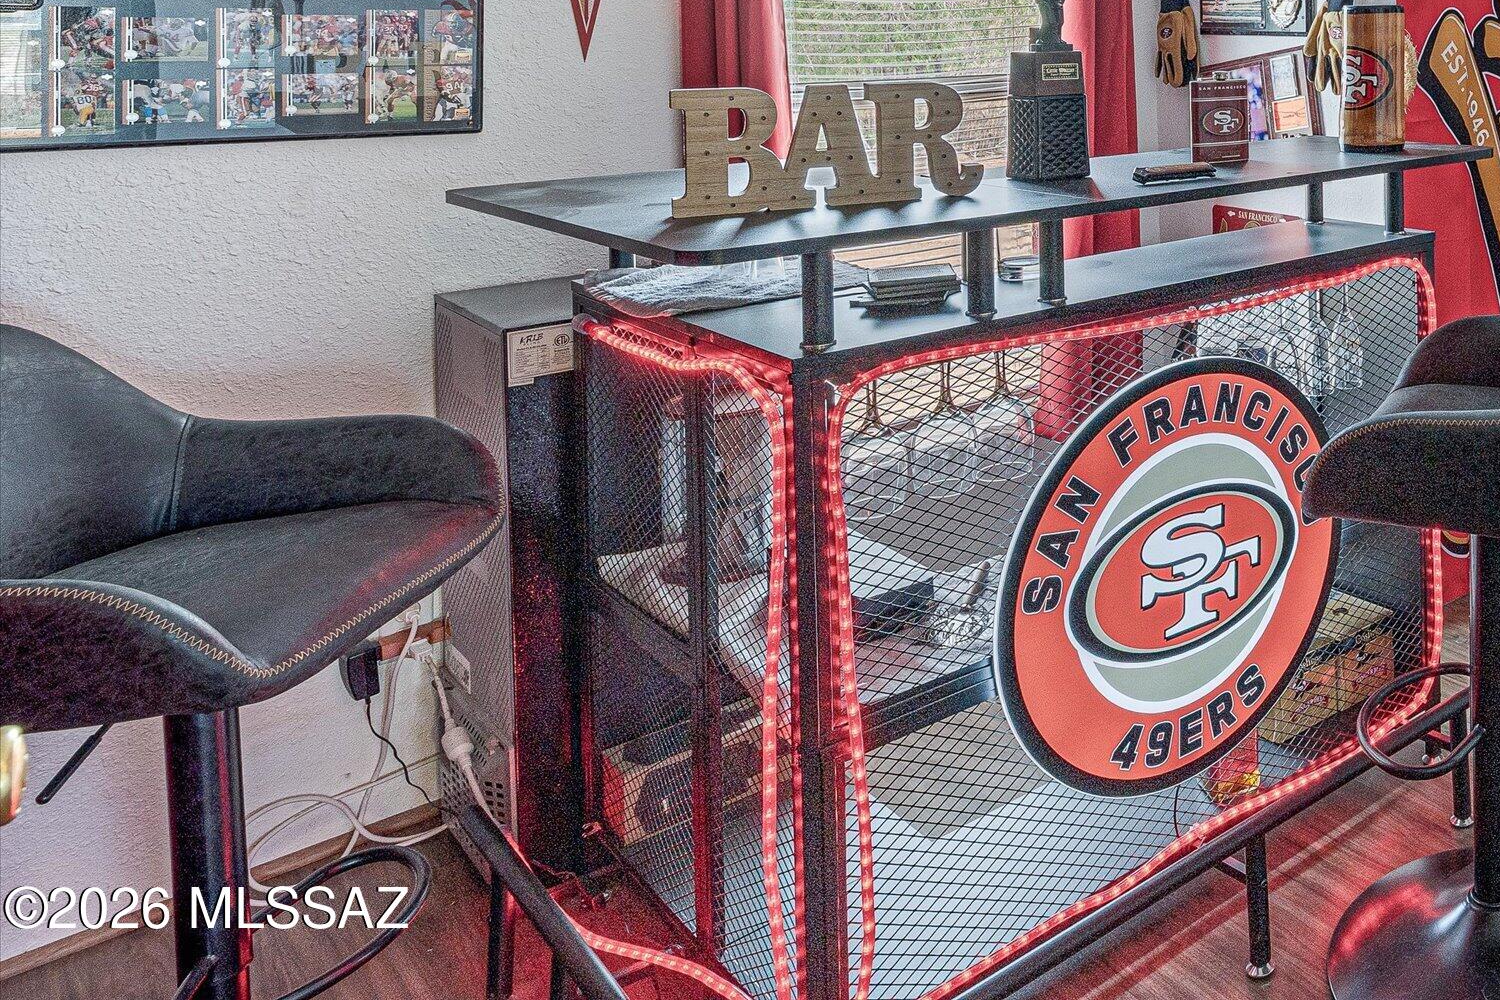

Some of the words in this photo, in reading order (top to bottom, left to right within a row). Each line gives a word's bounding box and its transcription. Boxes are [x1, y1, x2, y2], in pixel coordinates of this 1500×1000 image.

[1214, 110, 1239, 133] SF
[1441, 41, 1468, 92] EST.
[1466, 90, 1489, 146] 1946
[669, 82, 984, 219] BAR
[1238, 210, 1248, 219] SAN
[1248, 212, 1278, 224] FRANCISCO
[1022, 476, 1101, 616] SAN
[1107, 382, 1322, 527] FRANCISC
[1141, 503, 1262, 642] SF
[1110, 663, 1266, 771] 49ERS
